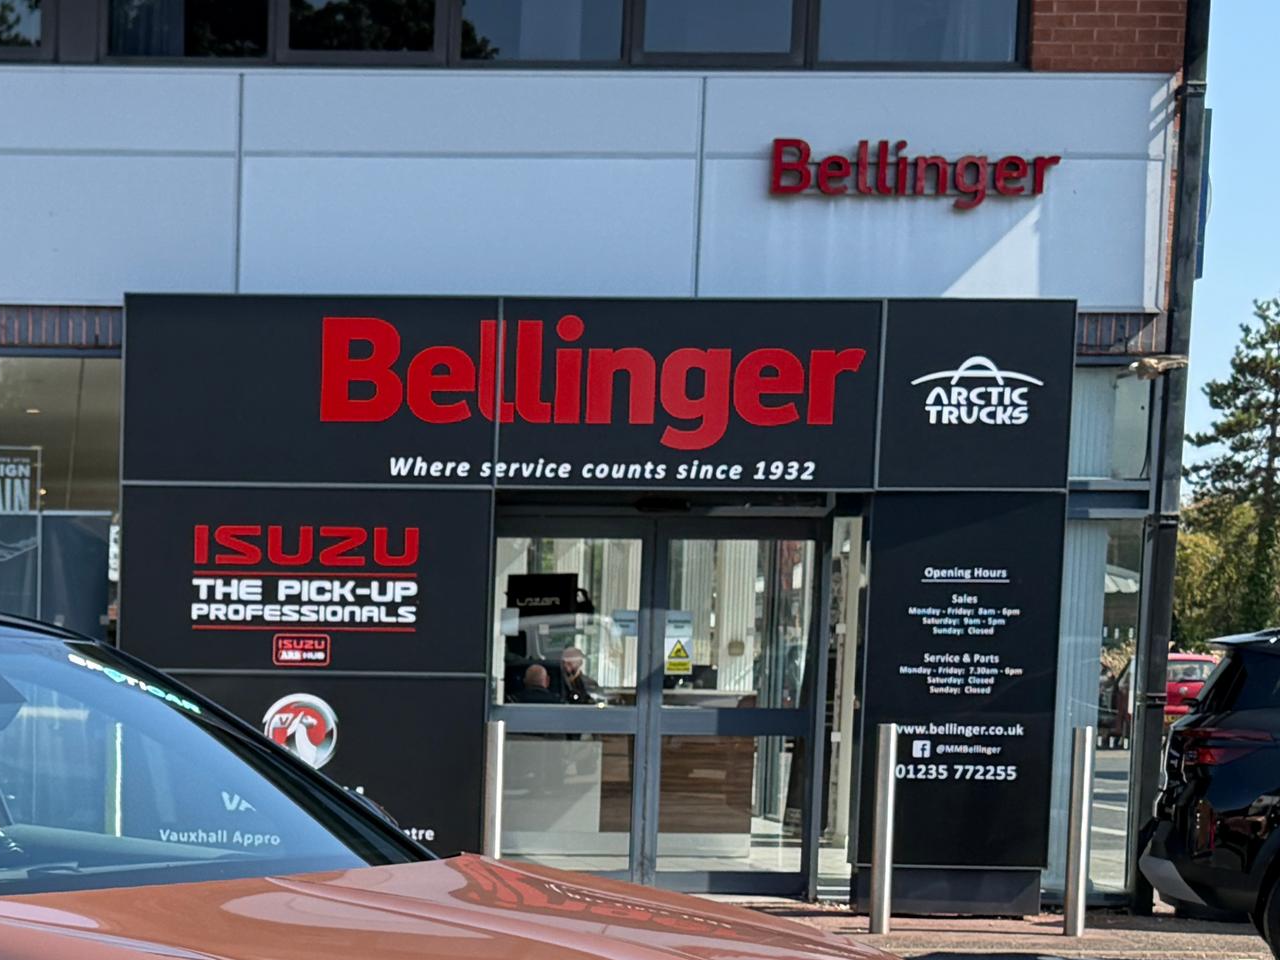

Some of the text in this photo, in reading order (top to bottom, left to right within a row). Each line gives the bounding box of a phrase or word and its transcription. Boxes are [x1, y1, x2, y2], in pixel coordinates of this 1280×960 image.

[771, 138, 1062, 210] Bellinger
[320, 314, 867, 450] Bellinger
[926, 387, 1028, 405] ARCTIC
[925, 406, 1028, 424] TRUCKS
[389, 456, 815, 480] Where service counts since 1932
[194, 525, 420, 567] ISUZU
[924, 566, 1007, 579] Opening Hours
[192, 578, 418, 602] THE PICK-UP
[951, 593, 978, 604] Sales
[191, 603, 417, 623] PROFESSIONALS
[908, 606, 942, 617] Monday
[946, 606, 975, 617] Friday:
[922, 615, 960, 626] Saturday:
[932, 626, 995, 636] Sunday: Closed
[278, 639, 326, 649] ISUZU
[923, 652, 1000, 664] Service & Parts
[899, 665, 932, 676] Monday
[937, 666, 966, 676] Friday:
[926, 675, 995, 686] Saturday: Closed
[929, 685, 992, 695] Sunday: Closed
[935, 744, 1002, 756] @MMBellinger
[895, 764, 1017, 781] 01235 772255
[158, 829, 227, 845] Vauxhall
[233, 831, 280, 846] Appro
